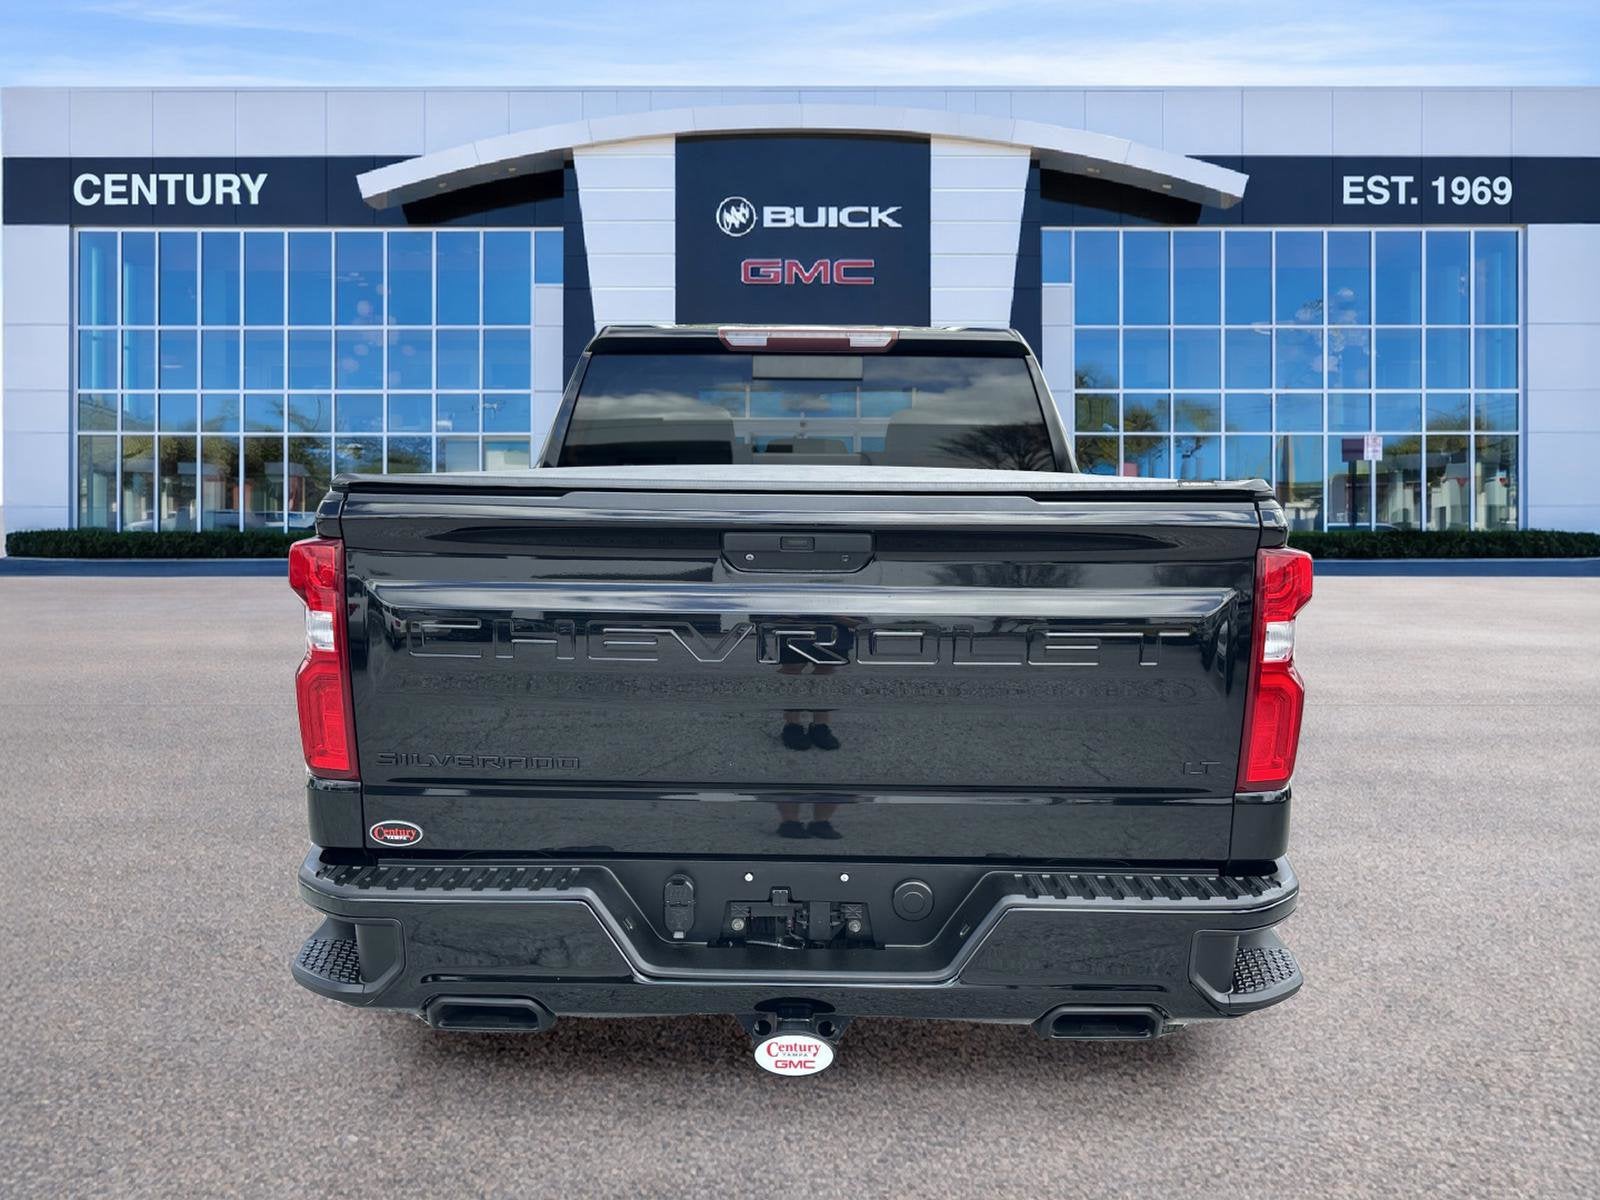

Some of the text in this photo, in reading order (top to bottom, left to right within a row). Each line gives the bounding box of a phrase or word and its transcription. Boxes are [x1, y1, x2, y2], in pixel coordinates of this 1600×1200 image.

[73, 173, 268, 206] CENTURY
[1342, 175, 1513, 205] EST. 1969
[762, 206, 903, 228] BUICK
[740, 258, 875, 285] GMC
[406, 617, 1193, 667] CHEVROLET
[375, 752, 581, 770] SILVERADO
[1182, 760, 1222, 776] LT
[373, 826, 417, 841] Century
[766, 1041, 821, 1058] Century
[774, 1059, 817, 1070] GMC
